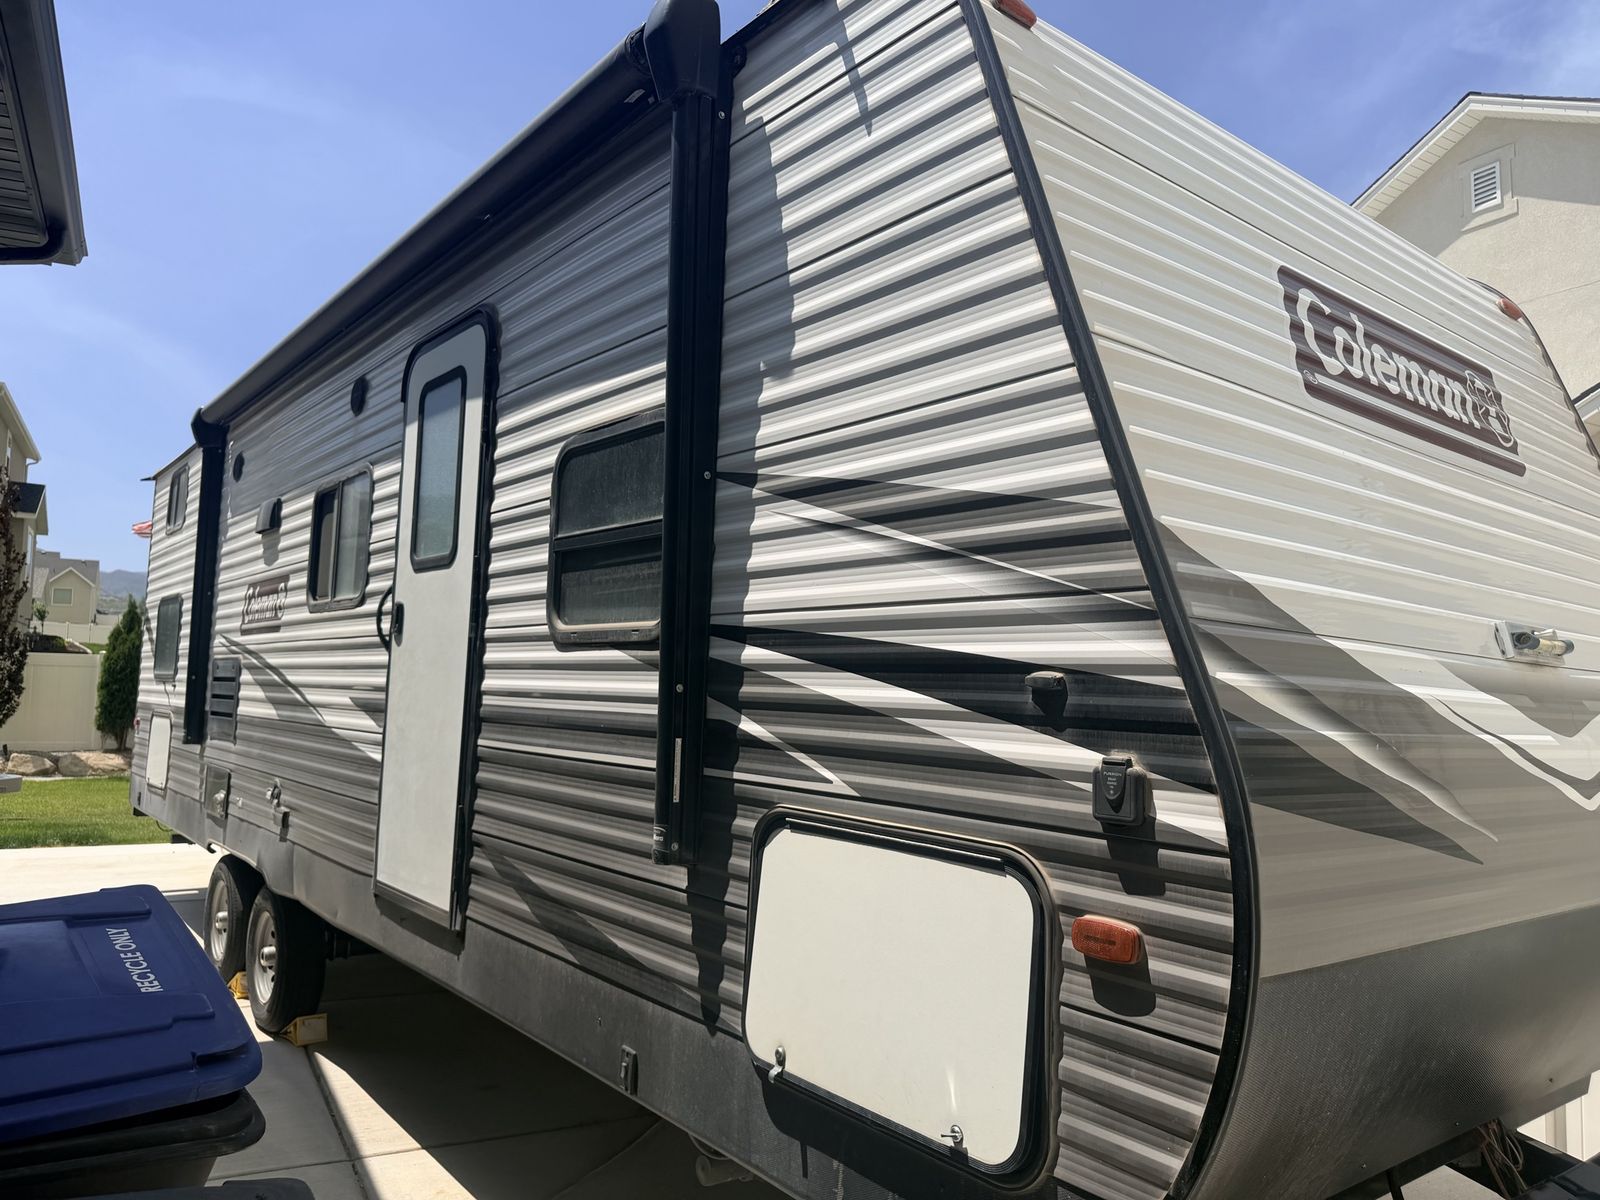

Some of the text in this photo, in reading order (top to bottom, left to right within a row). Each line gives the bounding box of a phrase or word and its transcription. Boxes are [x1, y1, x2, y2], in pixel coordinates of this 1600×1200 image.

[1296, 288, 1481, 429] Coleman
[244, 586, 276, 624] Coleman
[105, 928, 164, 993] RECYCLE ONLY
